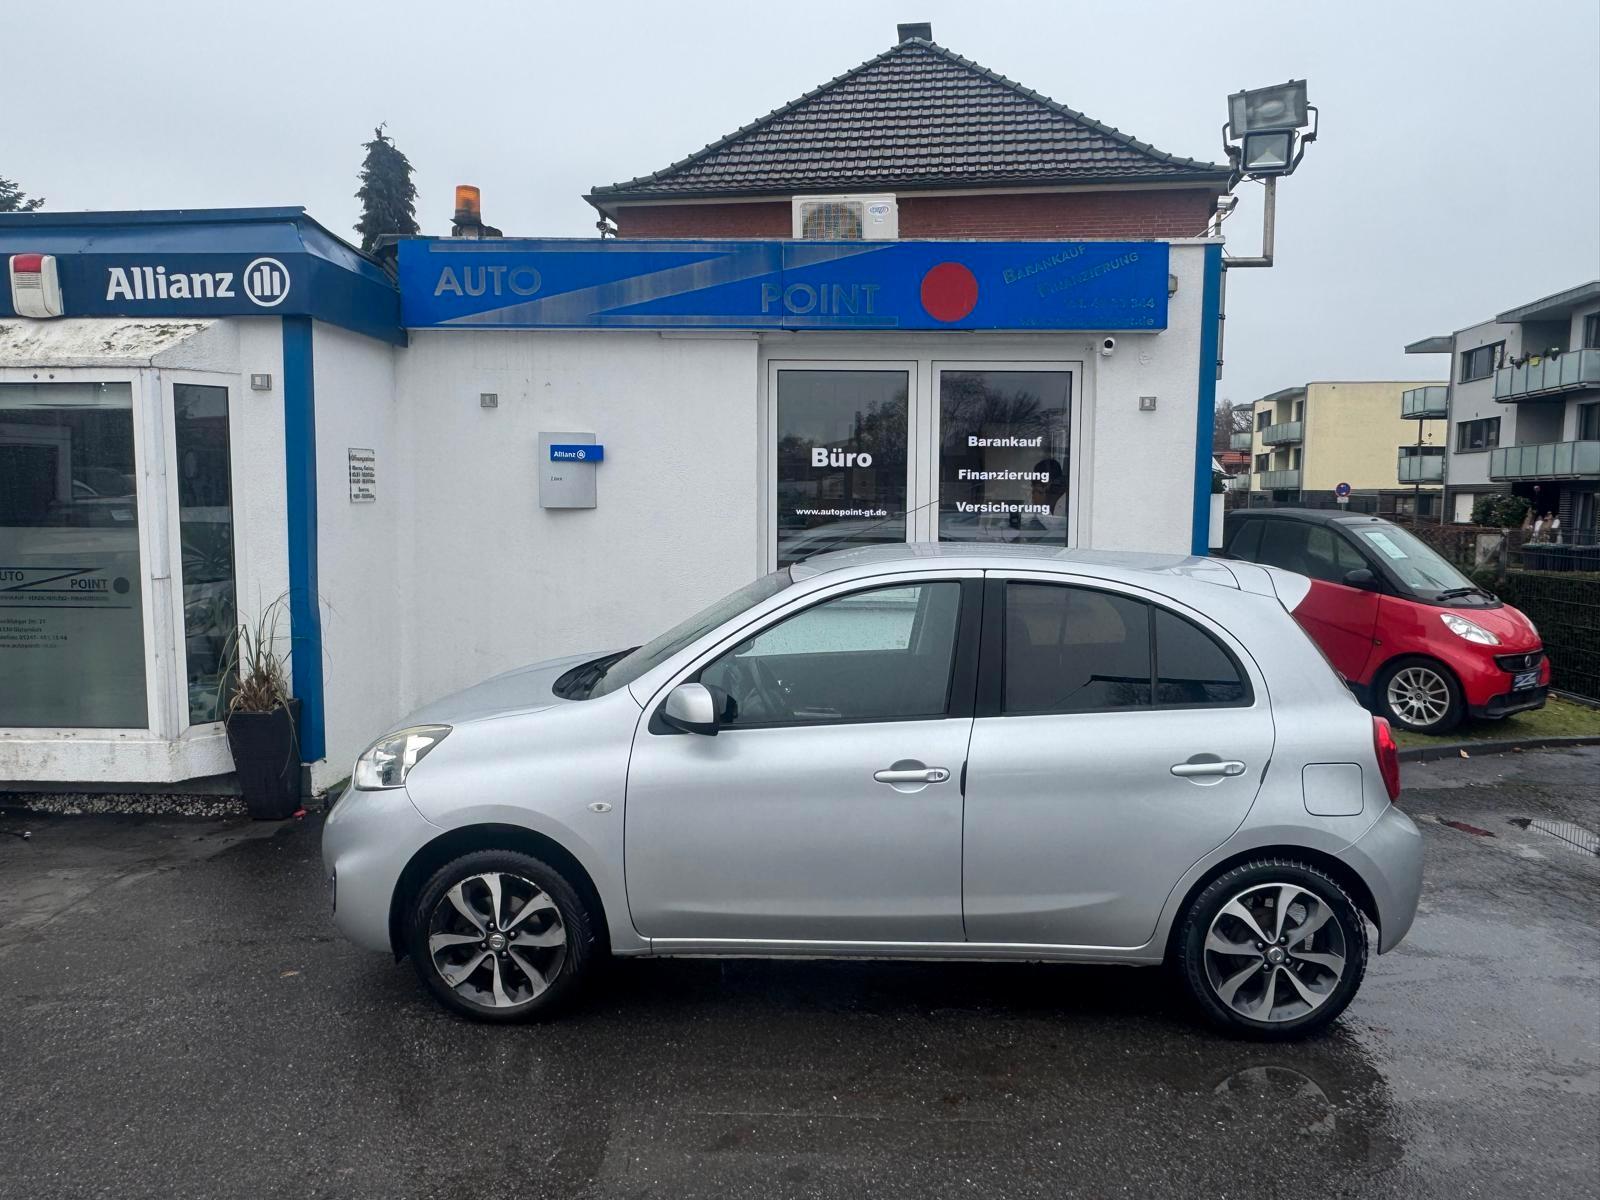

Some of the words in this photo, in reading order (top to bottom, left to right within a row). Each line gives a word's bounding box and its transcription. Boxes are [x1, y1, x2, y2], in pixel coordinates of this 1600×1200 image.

[106, 266, 236, 301] Allianz
[433, 265, 542, 296] AUTO
[761, 283, 880, 315] POINT
[968, 436, 1042, 447] Barankauf
[553, 450, 576, 458] Allianz
[811, 447, 873, 468] Büro
[958, 469, 1050, 483] Finanzierung
[795, 507, 888, 518] www.autopoint-gt.de
[955, 501, 1050, 515] Versicherung
[0, 571, 24, 581] UTO
[70, 578, 108, 590] POINT
